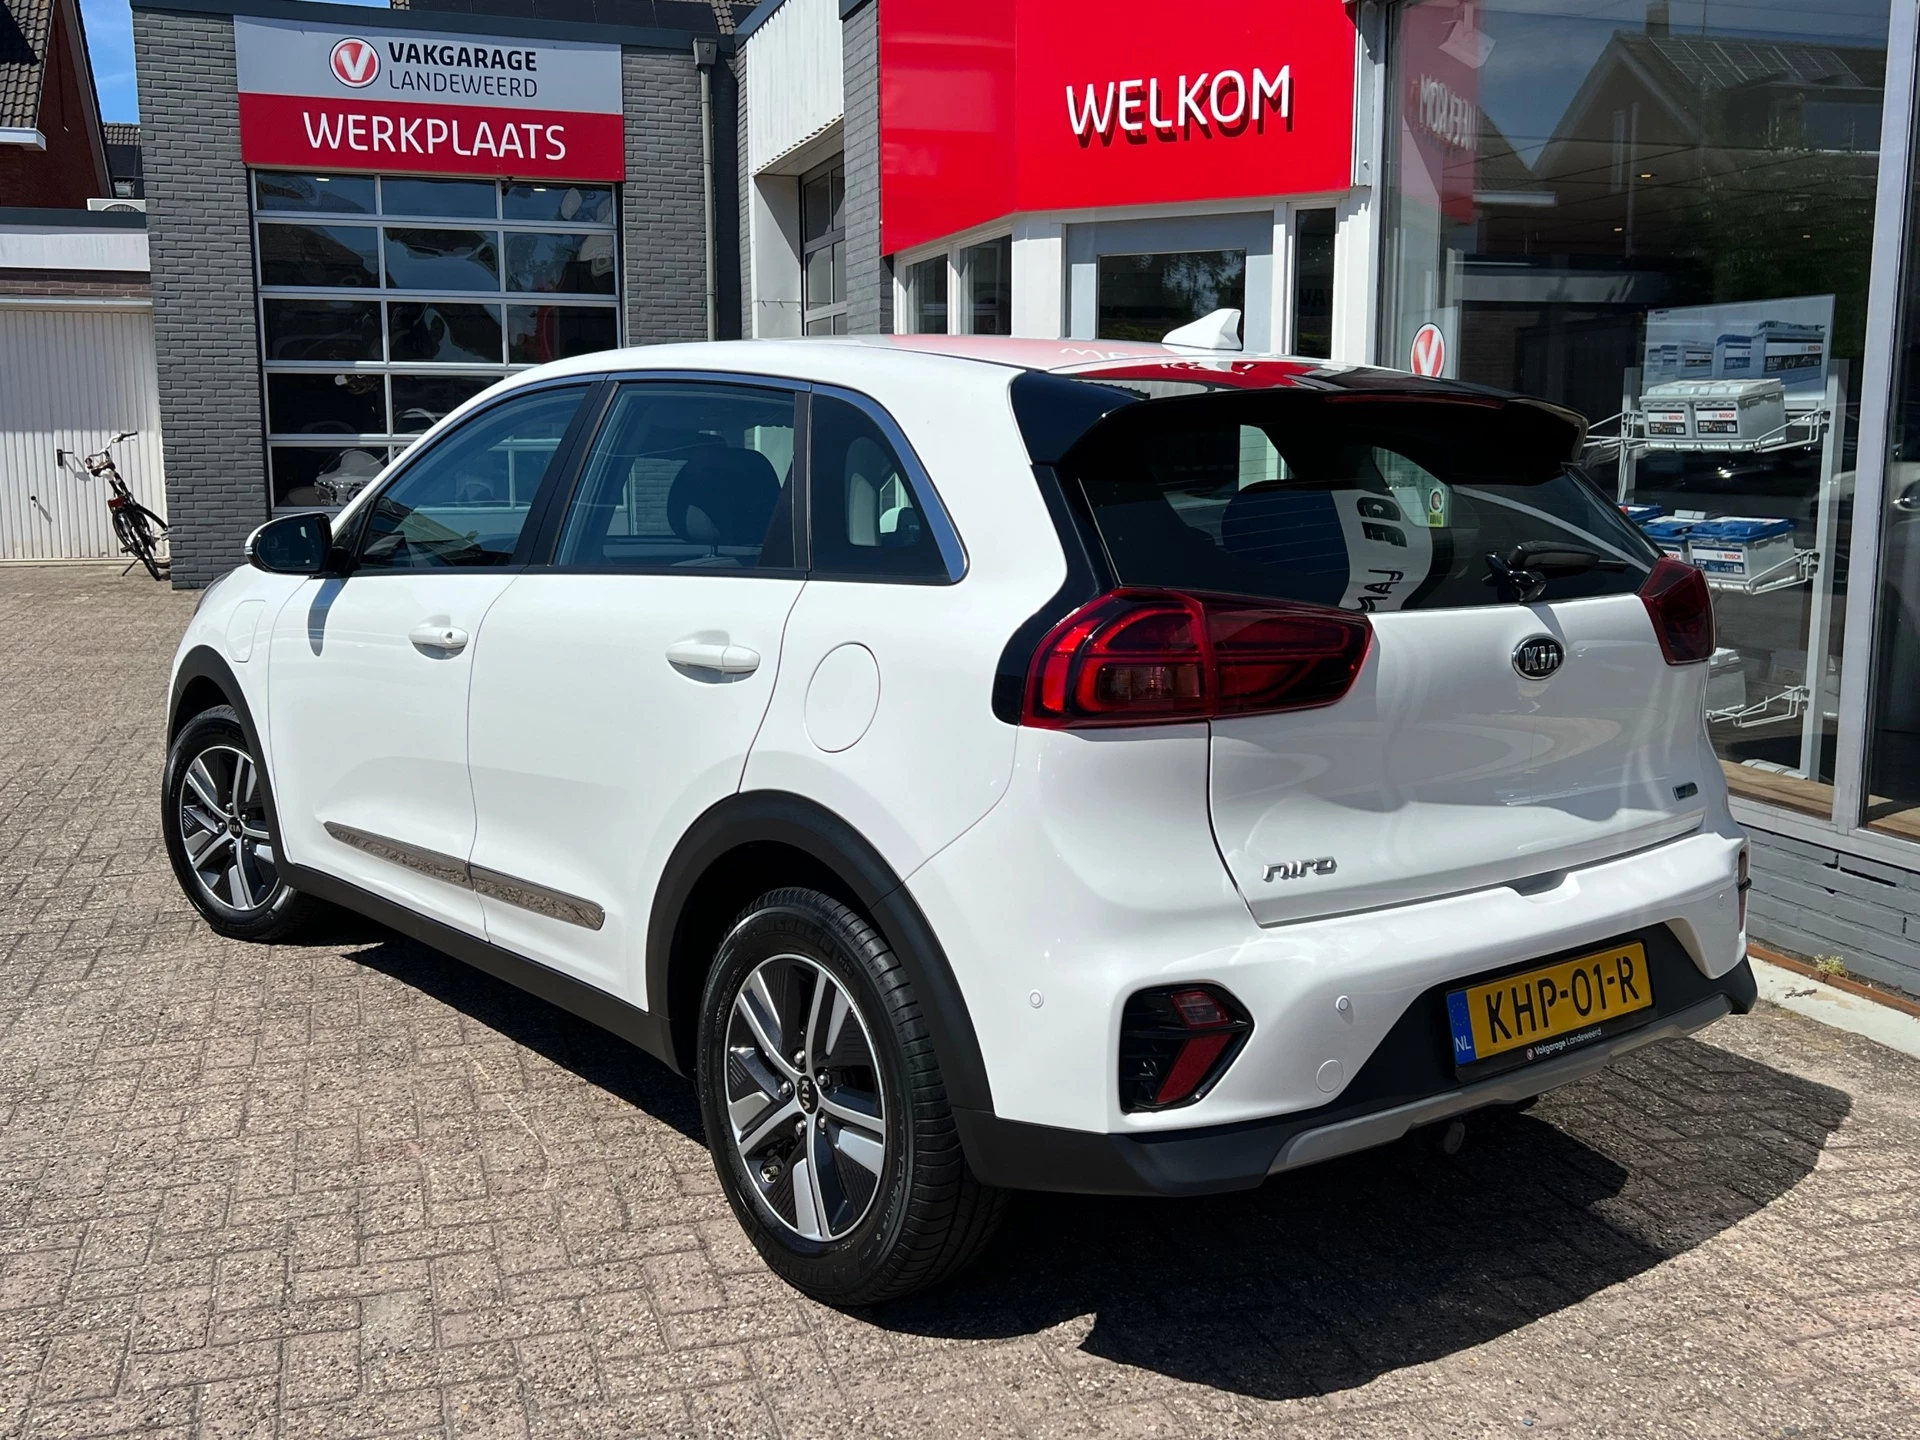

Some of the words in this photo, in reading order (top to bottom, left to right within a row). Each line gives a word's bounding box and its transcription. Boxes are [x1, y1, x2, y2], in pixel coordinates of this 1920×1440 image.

[388, 42, 537, 71] VAKGARAGE
[388, 70, 538, 98] LANDEWEERD
[1065, 64, 1291, 136] WELKOM
[302, 111, 566, 161] WERKPLAATS
[1807, 344, 1822, 352] BOSCH
[1724, 552, 1741, 560] BOSCH
[1523, 646, 1559, 671] KIA
[1262, 855, 1338, 883] niro
[1485, 956, 1640, 1043] KHP-01-R
[1455, 1037, 1472, 1052] NL
[1534, 1040, 1567, 1056] Vakgarage
[1566, 1027, 1602, 1046] Landeweerd
[801, 1080, 811, 1110] KIA
